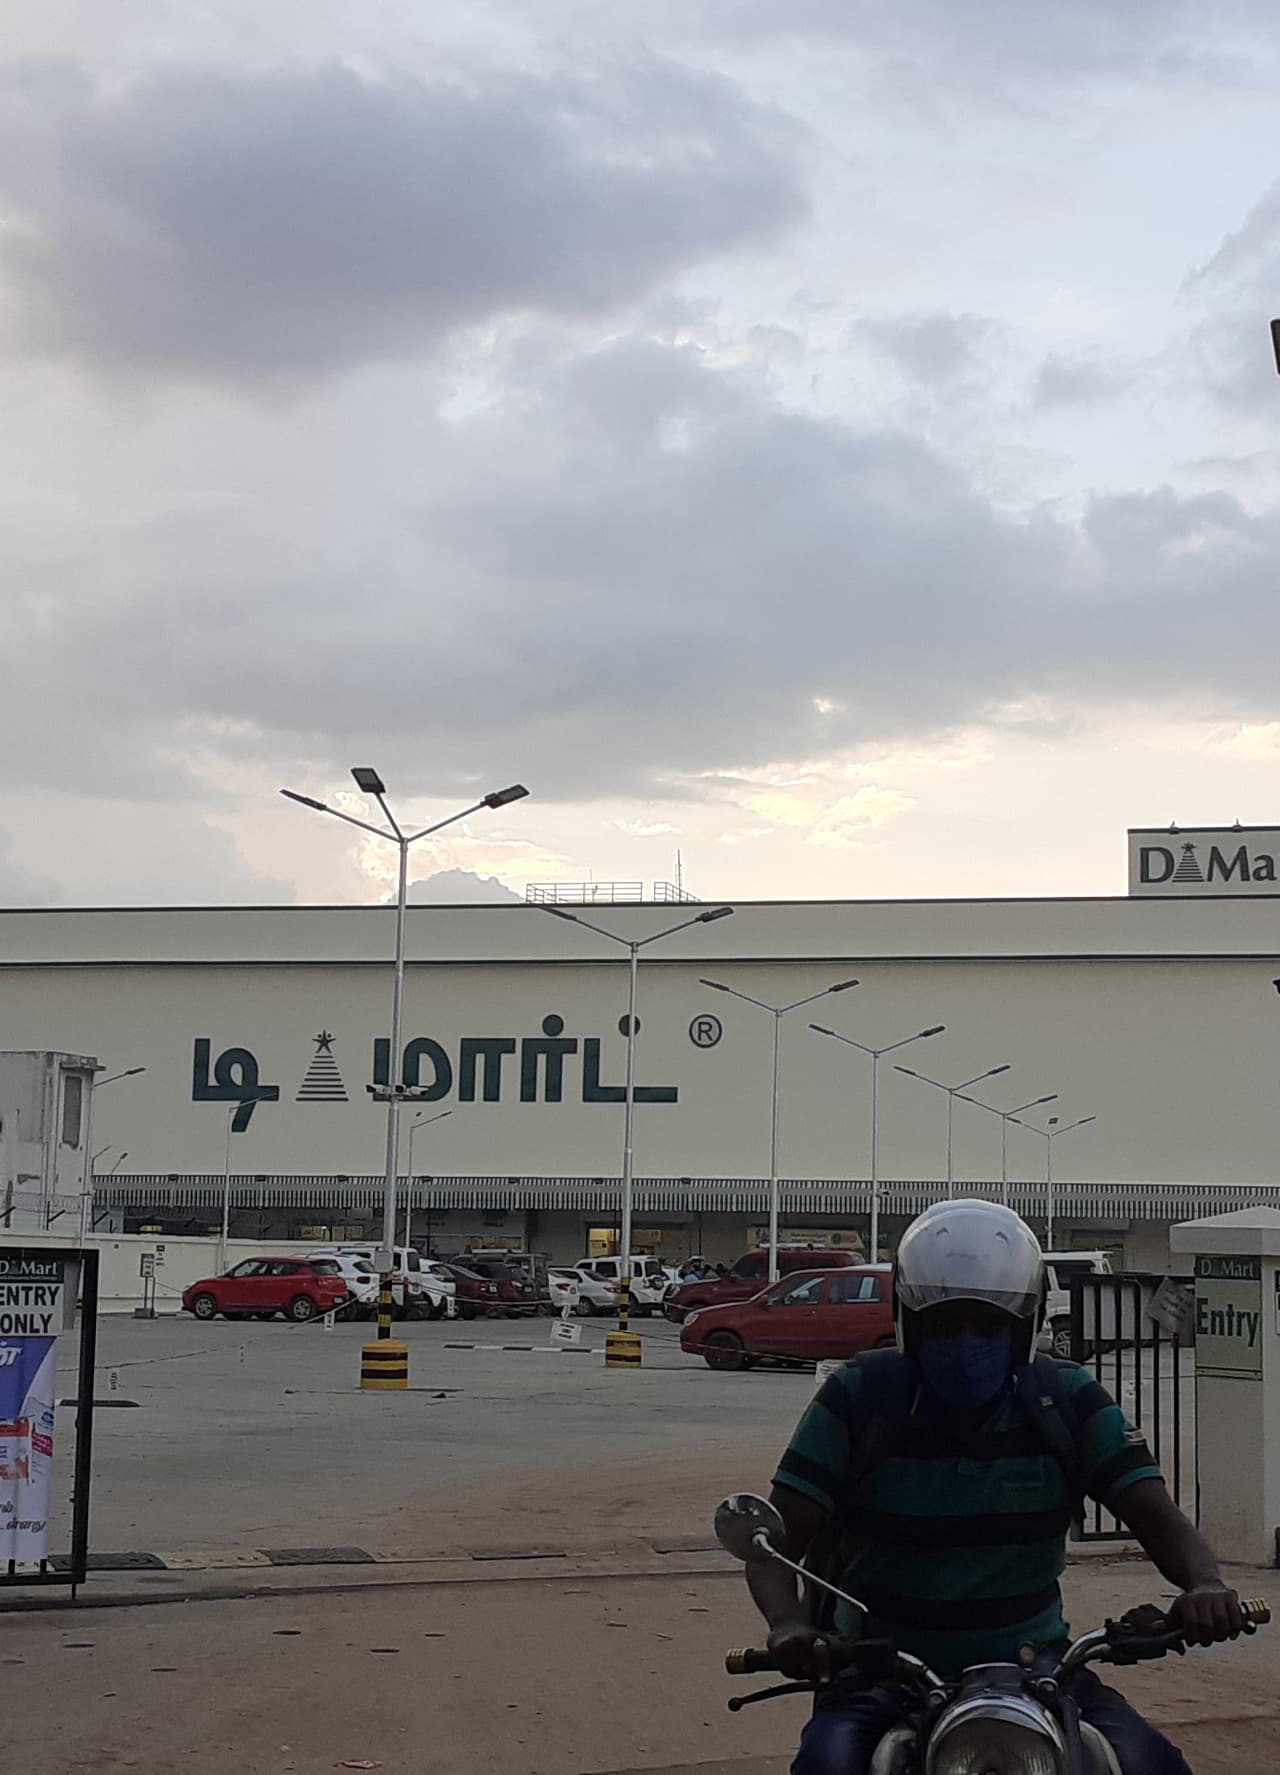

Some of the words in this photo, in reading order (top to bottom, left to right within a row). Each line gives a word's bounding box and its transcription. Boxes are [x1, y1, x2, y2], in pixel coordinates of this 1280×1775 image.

[192, 1037, 280, 1133] டி
[0, 1313, 53, 1334] ONLY
[1196, 1297, 1259, 1347] Entry
